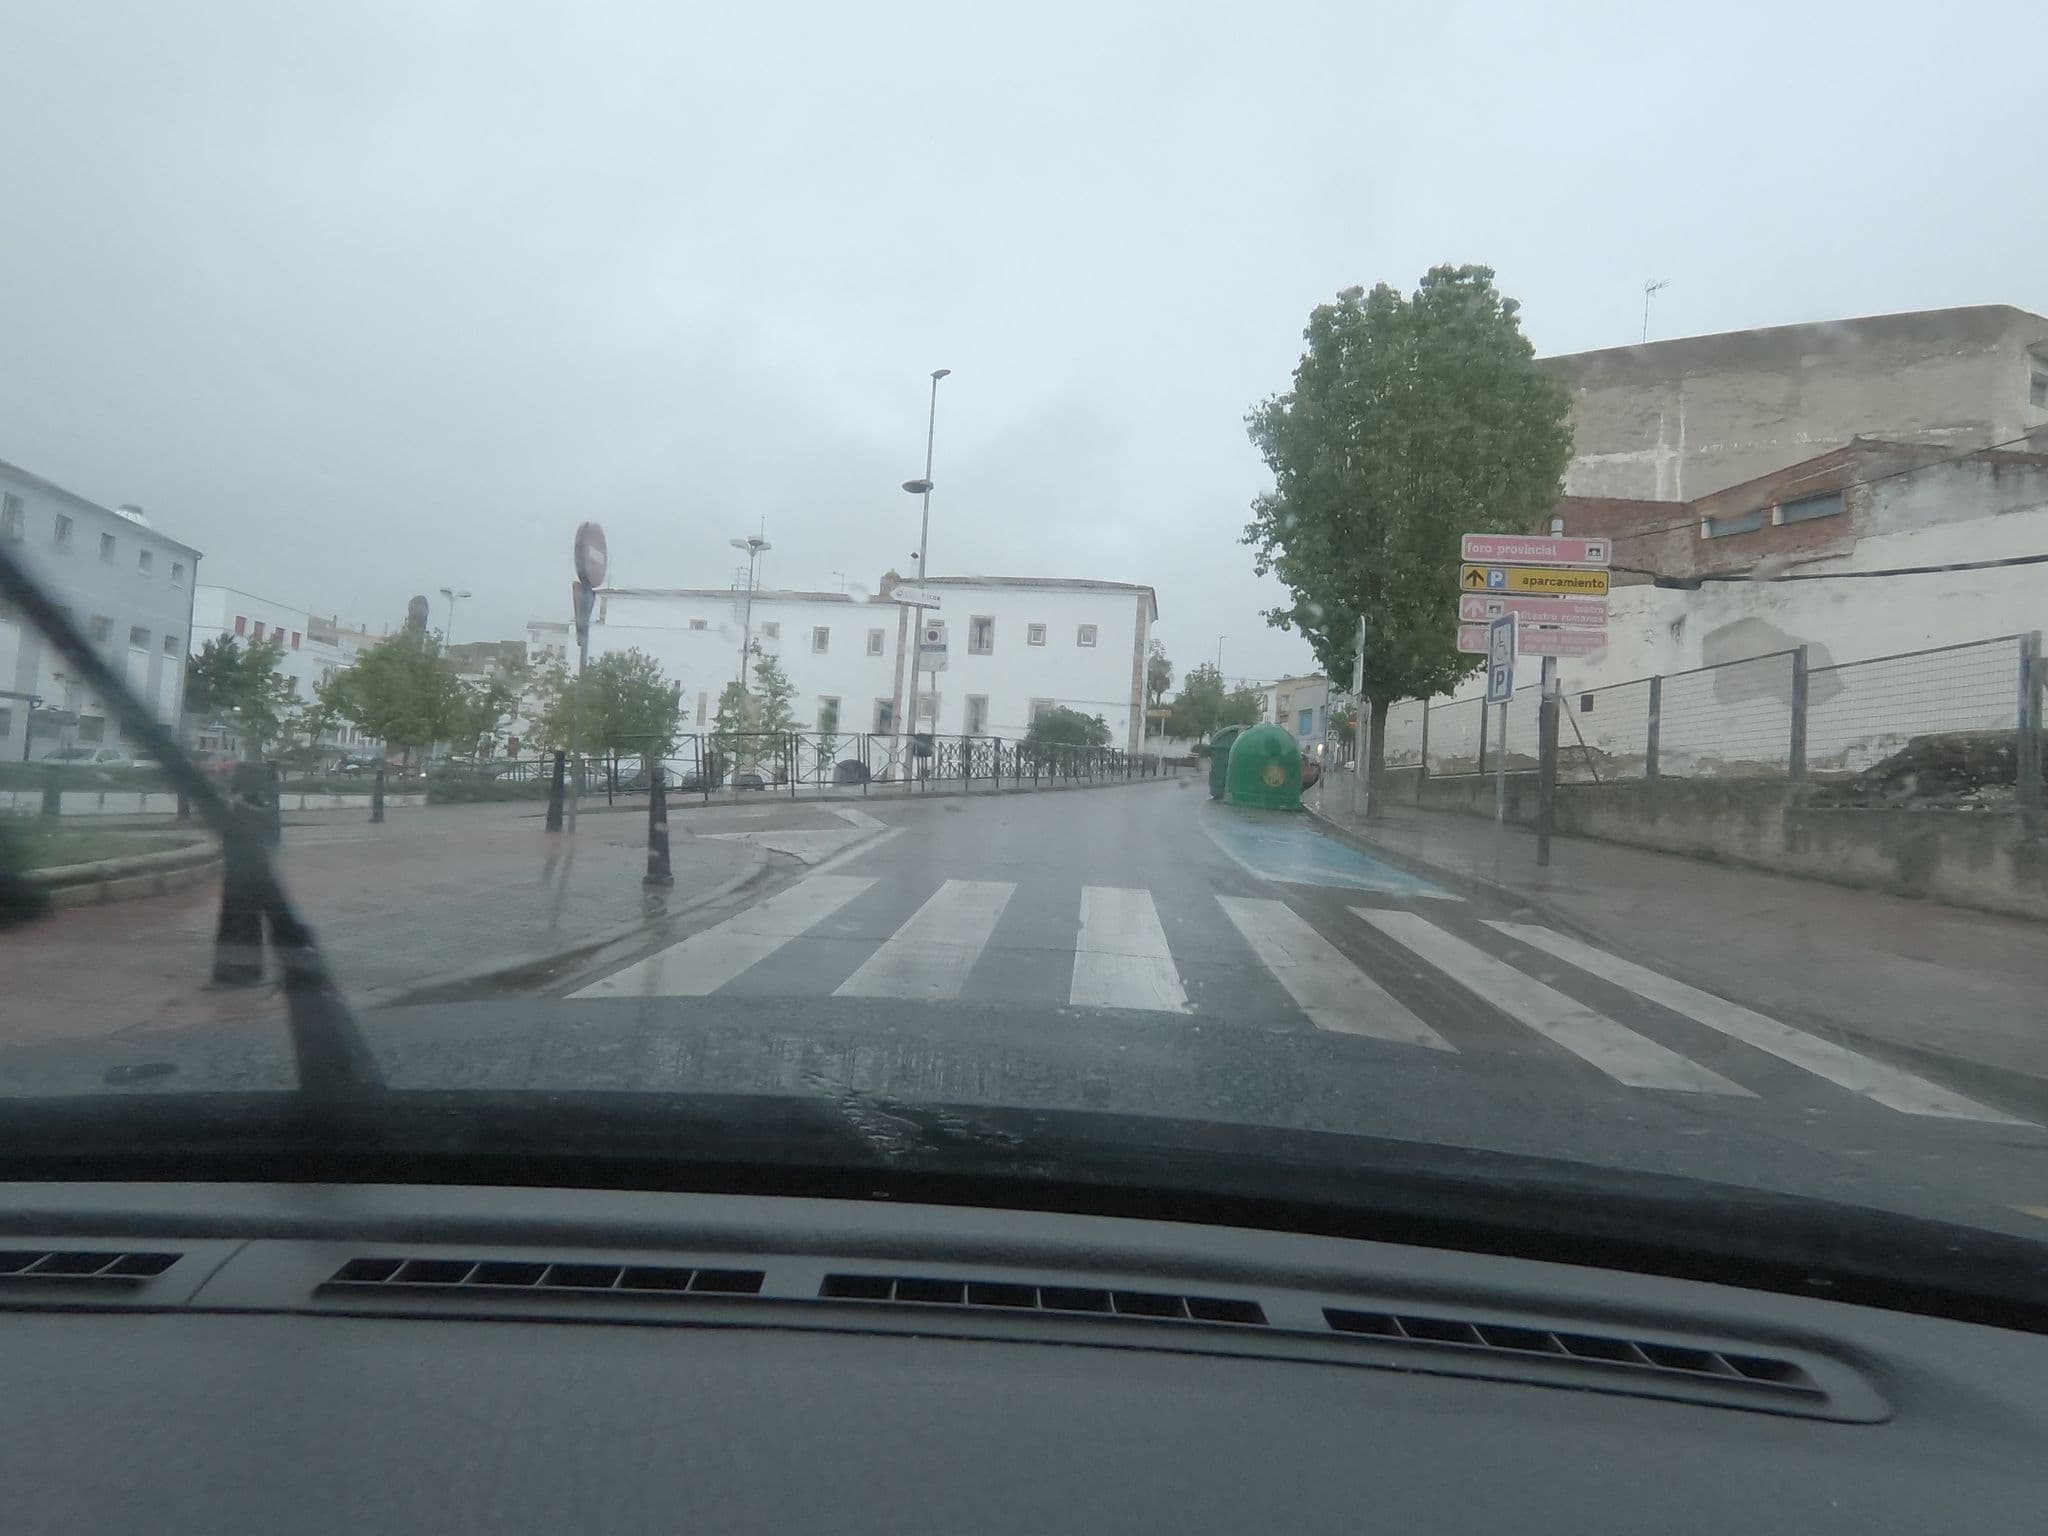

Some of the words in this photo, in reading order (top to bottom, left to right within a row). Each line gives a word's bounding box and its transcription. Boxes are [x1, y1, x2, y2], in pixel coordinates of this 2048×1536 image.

[1467, 542, 1492, 553] foro
[1497, 544, 1557, 557] provincial
[1490, 571, 1504, 587] P
[1522, 575, 1605, 588] aparcamiento
[1496, 670, 1505, 694] P
